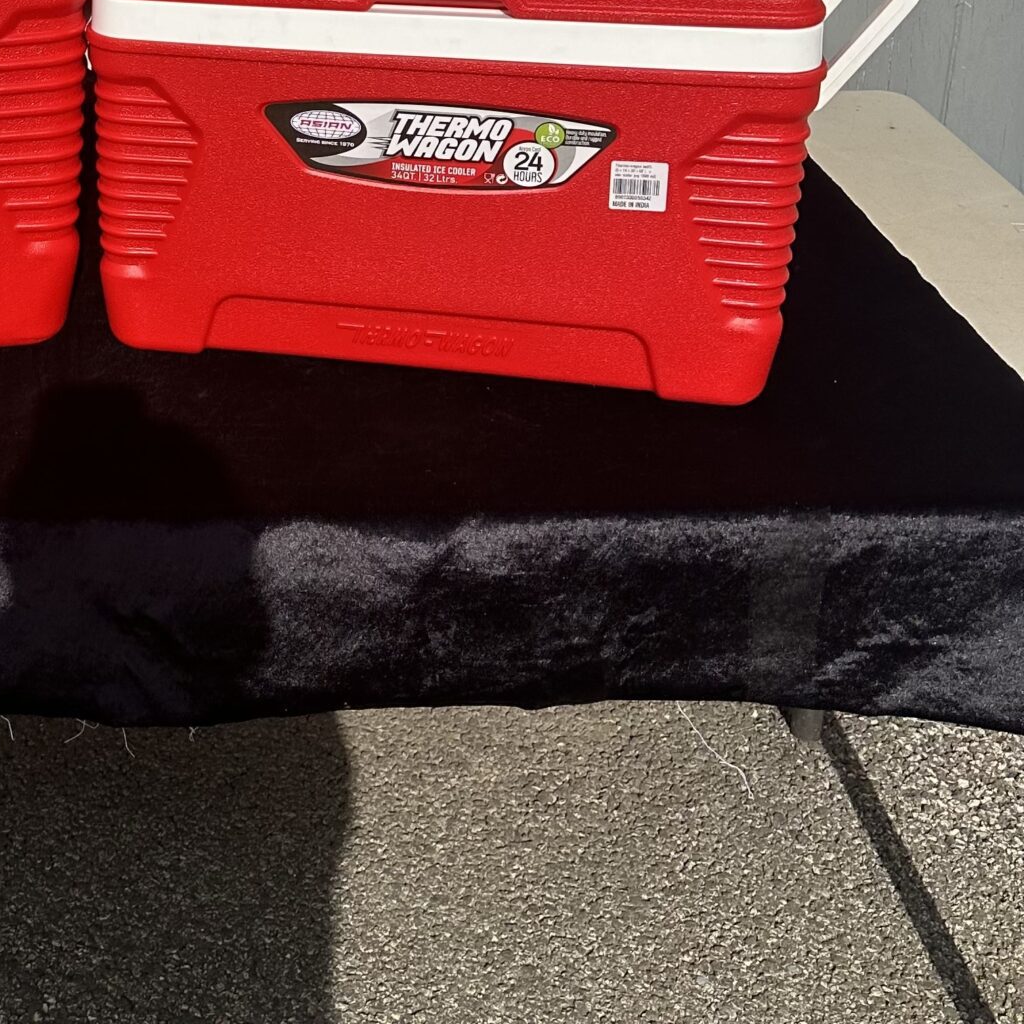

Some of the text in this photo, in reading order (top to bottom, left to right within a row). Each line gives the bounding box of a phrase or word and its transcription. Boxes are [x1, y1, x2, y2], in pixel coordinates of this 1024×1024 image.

[300, 119, 352, 130] ASIAN
[395, 113, 514, 141] THERMO
[540, 135, 560, 143] ECO
[385, 134, 504, 163] WAGON
[514, 152, 543, 171] 24
[391, 162, 476, 176] INSULATED ICE COOLER
[391, 170, 458, 184] 34QT. 32 Ltrs.
[513, 171, 543, 183] HOURS
